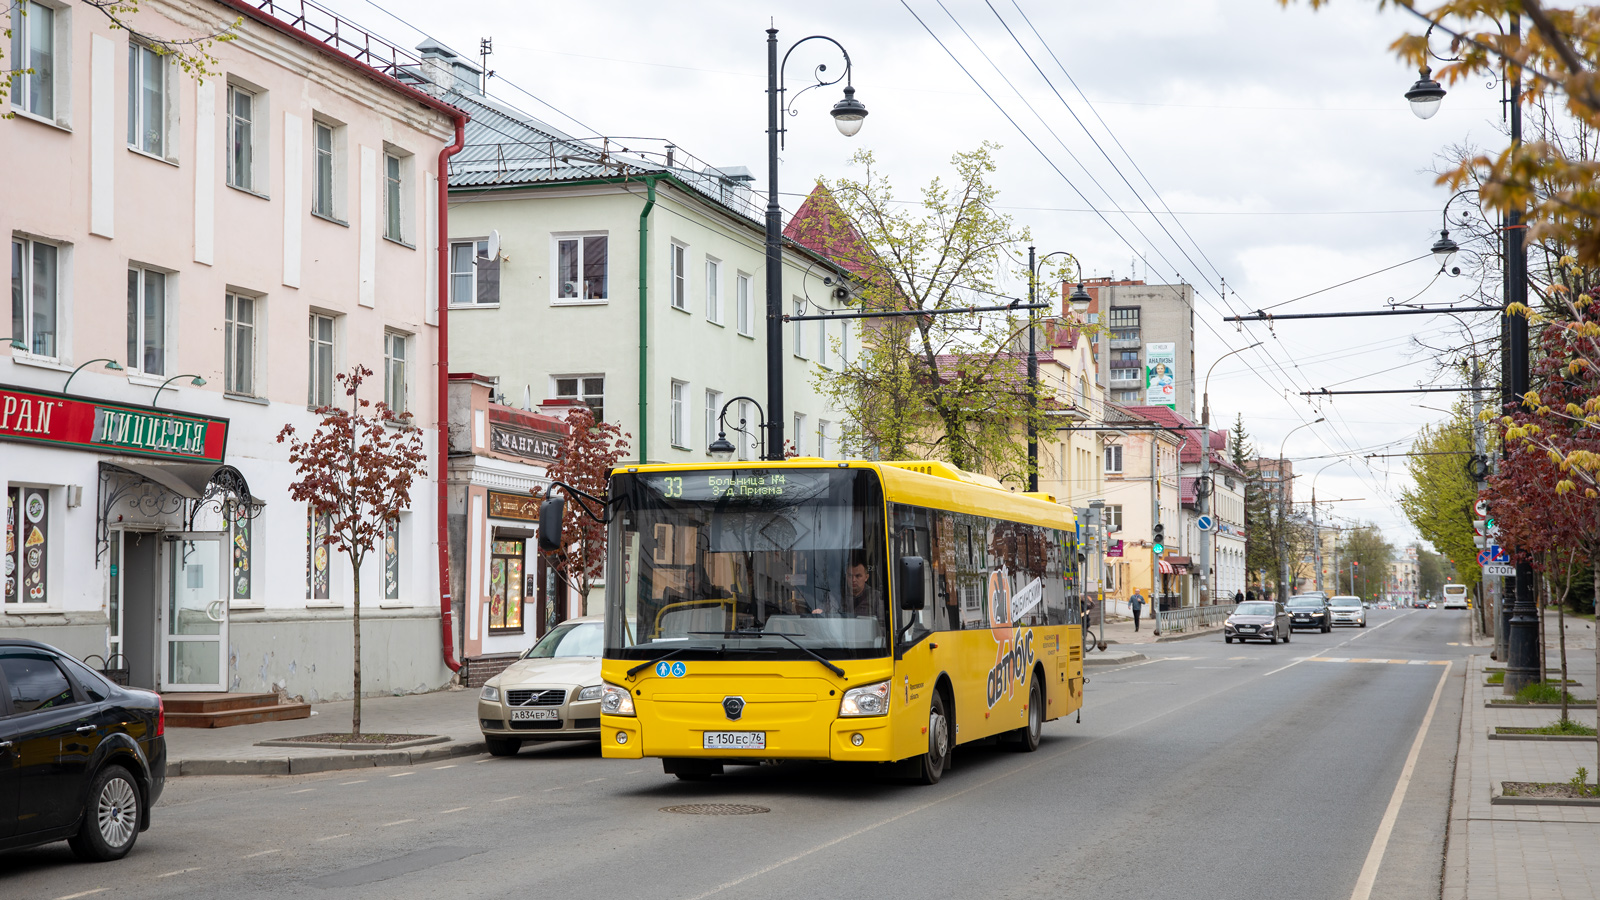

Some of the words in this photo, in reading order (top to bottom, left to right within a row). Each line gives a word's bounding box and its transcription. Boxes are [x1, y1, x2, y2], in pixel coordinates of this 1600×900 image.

[100, 410, 205, 453] ПИЦЦЕРІЯ
[663, 476, 683, 498] 33
[708, 475, 765, 487] Больница
[740, 484, 783, 496] Призма
[1488, 566, 1513, 574] СТОП
[751, 733, 762, 742] 76
